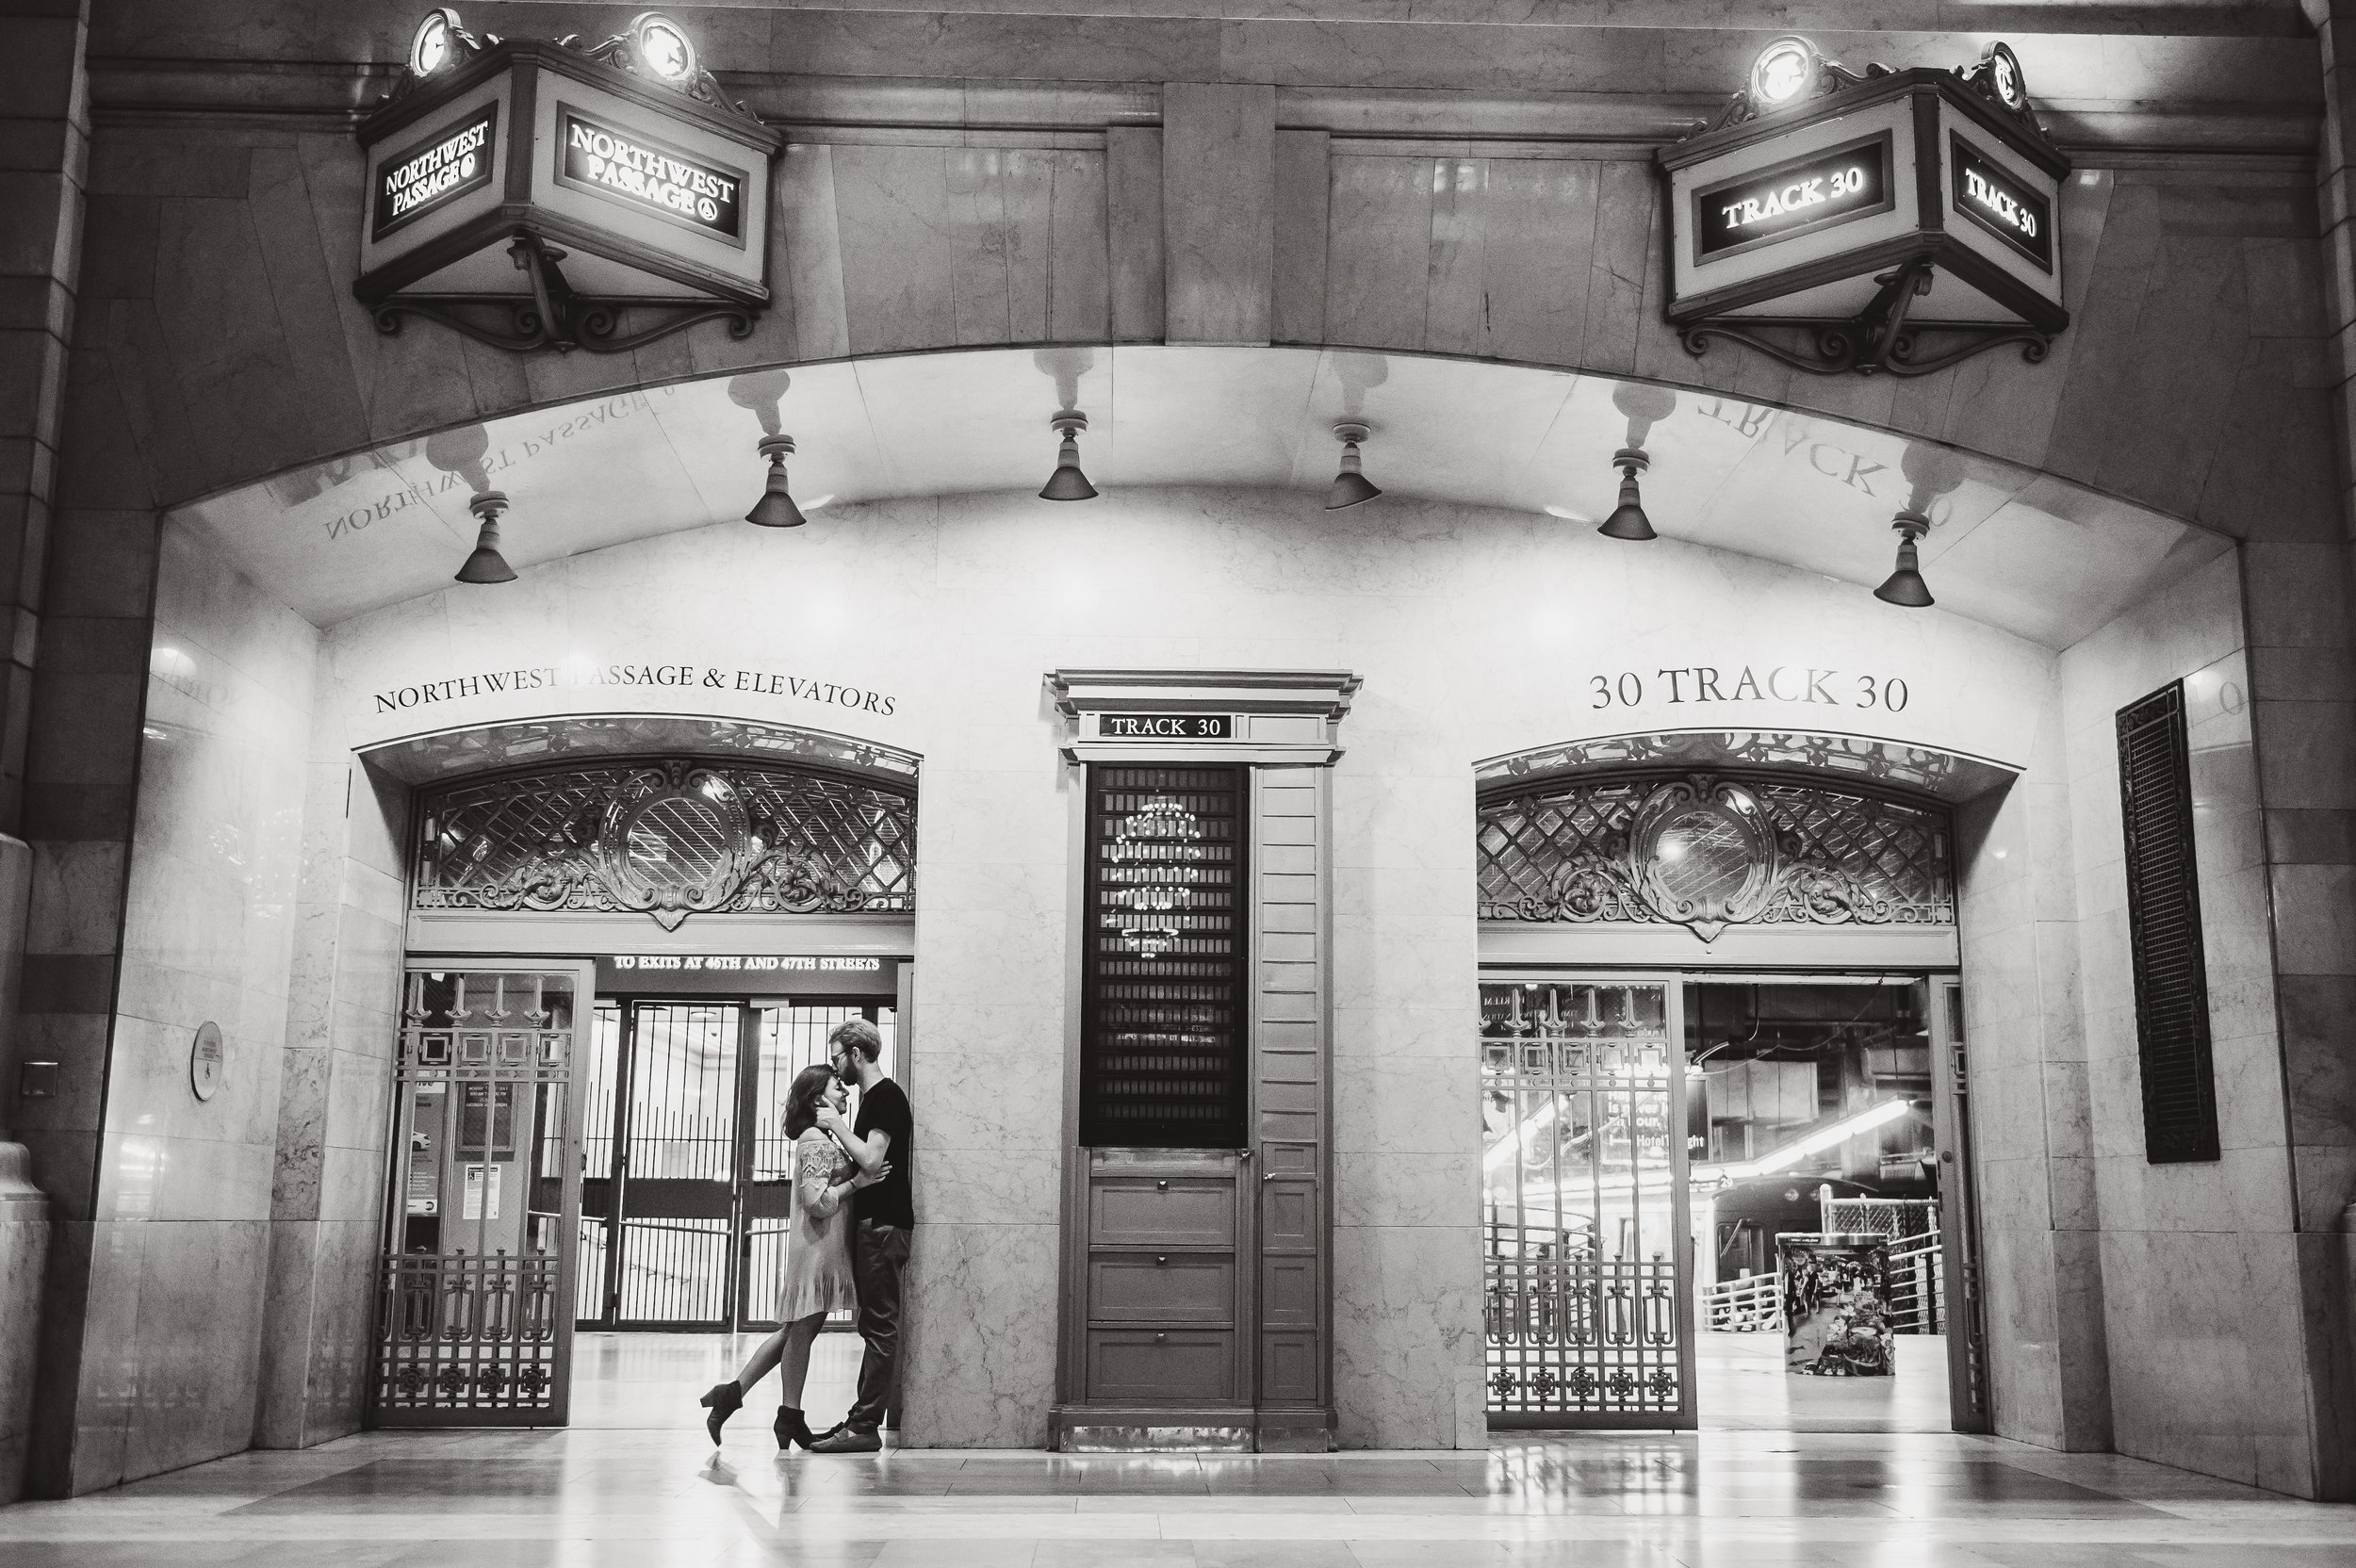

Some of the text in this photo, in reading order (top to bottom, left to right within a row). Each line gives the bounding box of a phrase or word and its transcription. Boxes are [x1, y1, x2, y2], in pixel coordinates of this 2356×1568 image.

[386, 121, 488, 195] NORTHWEST
[570, 124, 734, 204] NORTHWEST
[587, 154, 695, 215] PASSAGE
[392, 159, 460, 216] PASSAGE
[1722, 167, 1864, 229] TRACK 30
[1965, 168, 2037, 237] TRACK 30
[373, 667, 561, 715] NORTHWEST
[702, 667, 726, 689] &
[734, 669, 896, 717] ELEVATORS
[1590, 665, 1908, 712] 30 TRACK 30
[1111, 718, 1220, 735] TRACK 30
[614, 956, 880, 971] TO EXITS AT 46TH AND 47TH STREETS
[1720, 1177, 1733, 1188] 29
